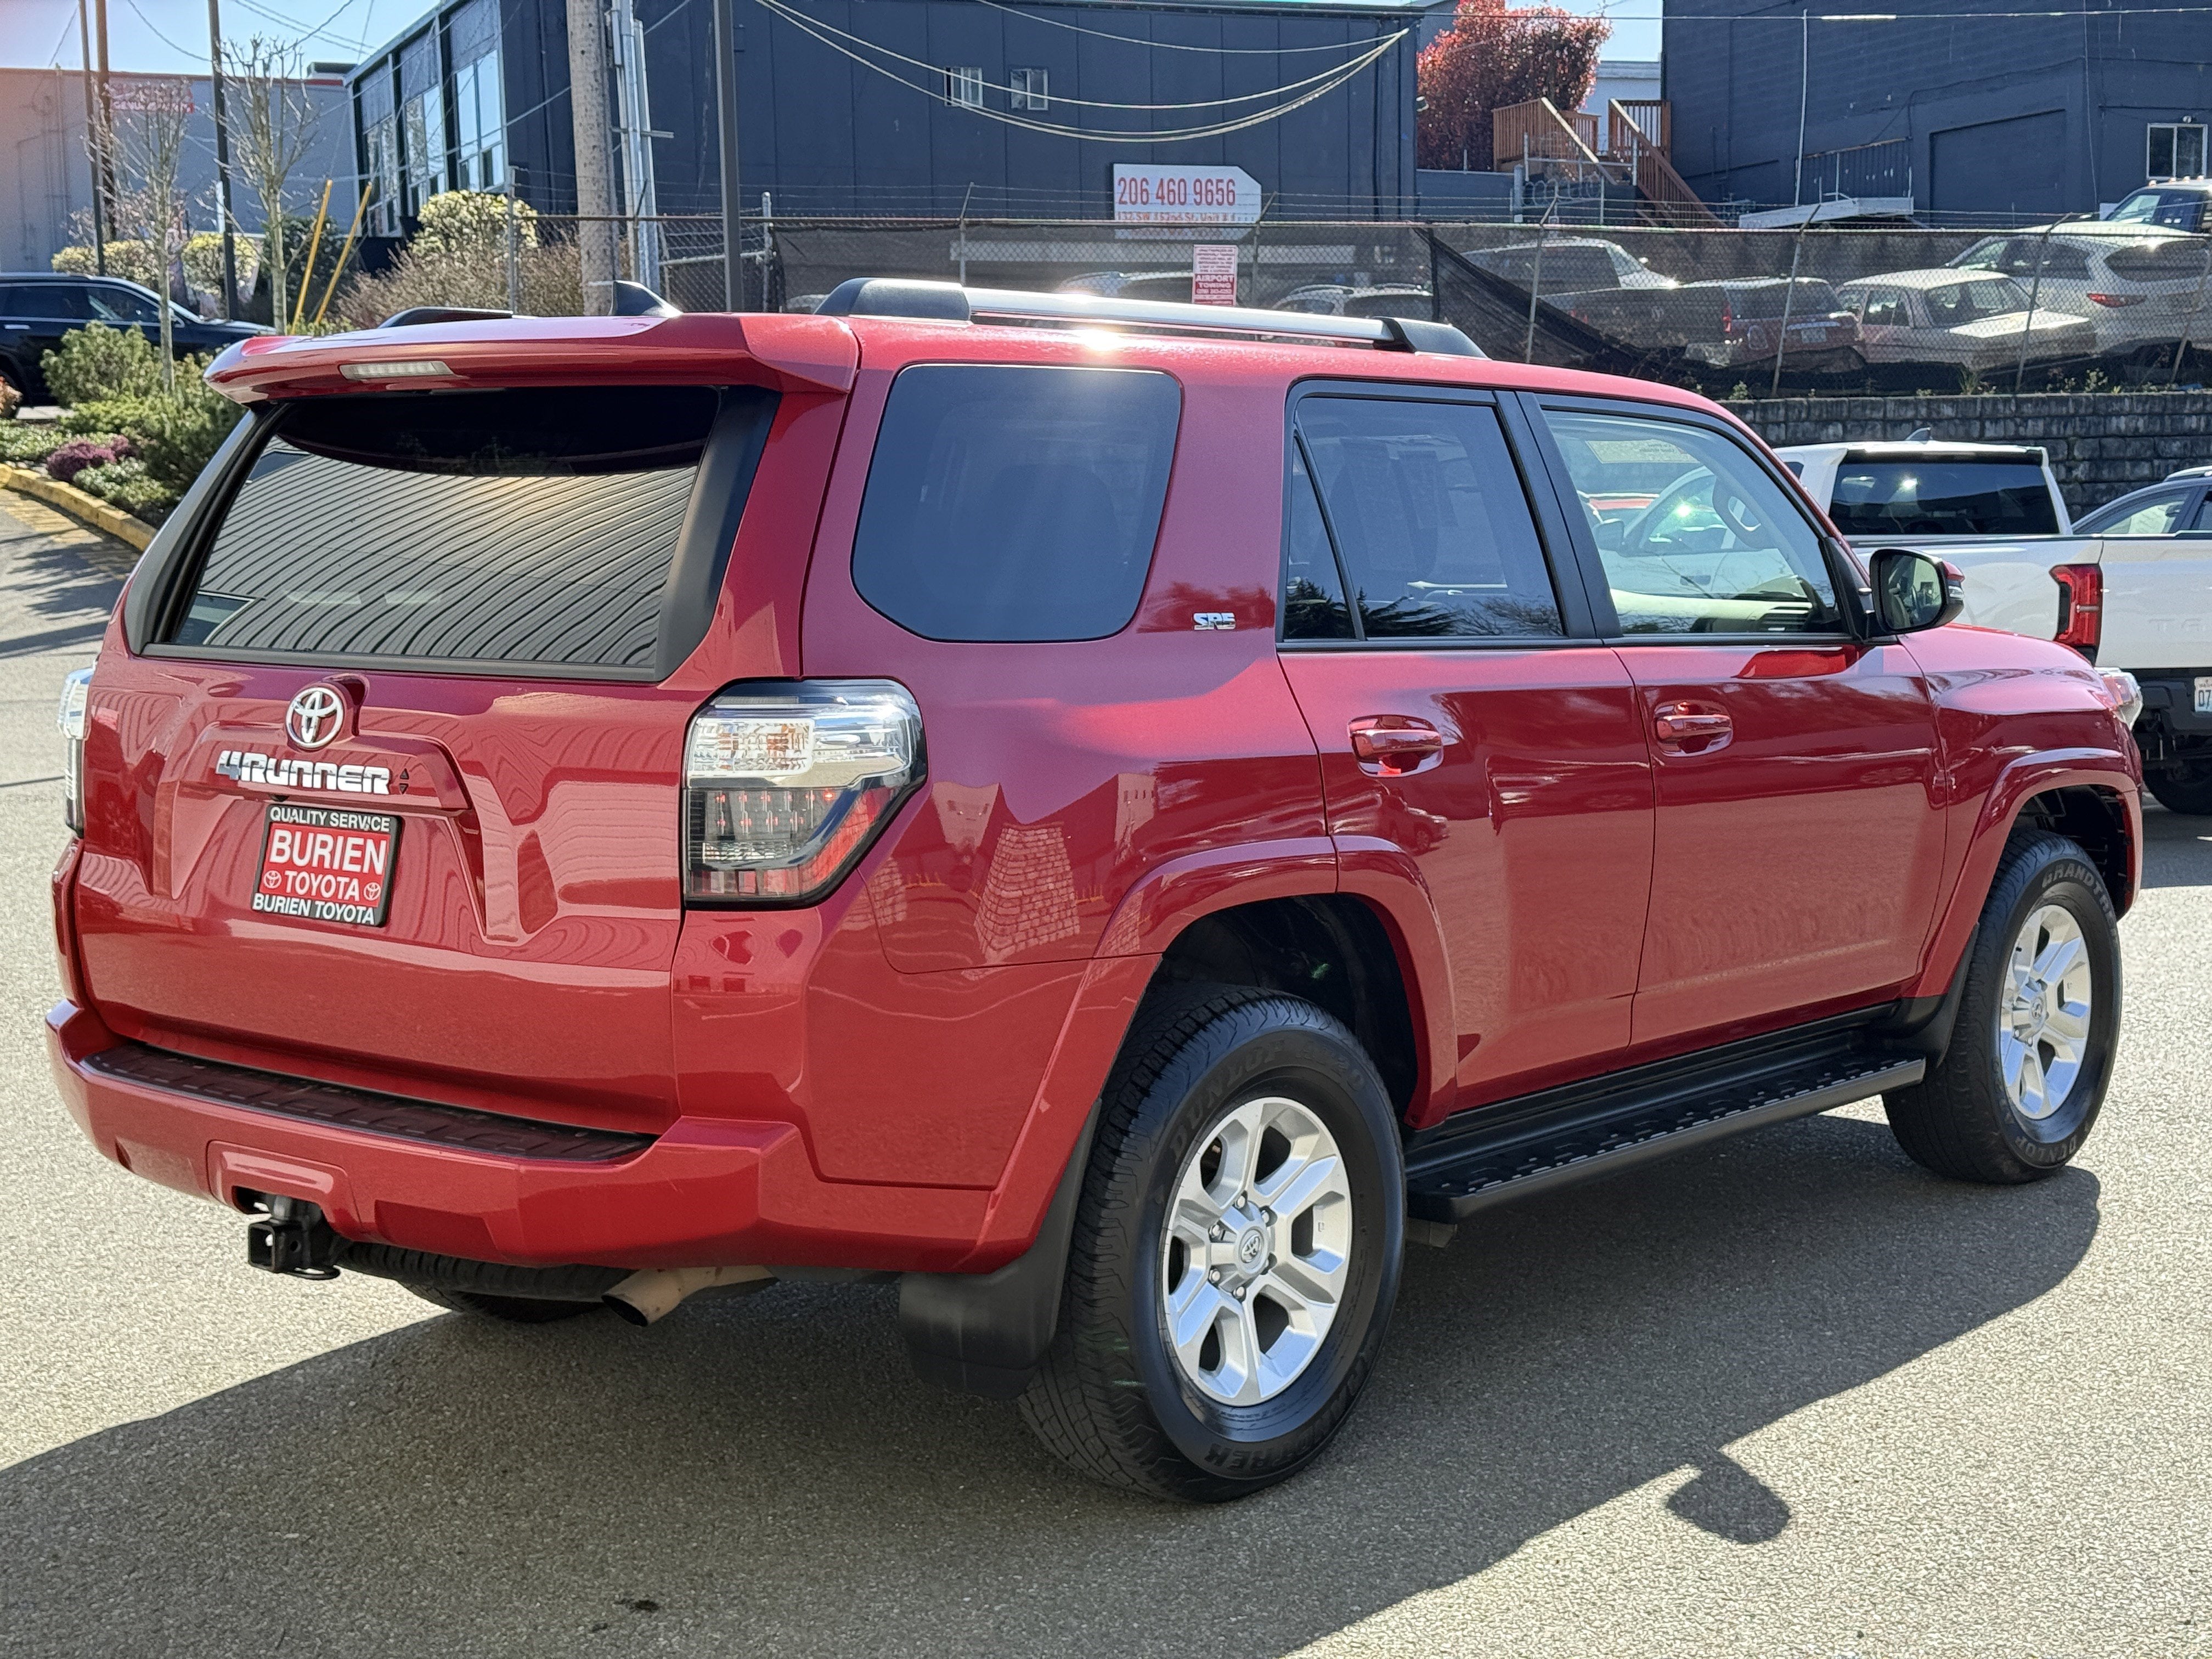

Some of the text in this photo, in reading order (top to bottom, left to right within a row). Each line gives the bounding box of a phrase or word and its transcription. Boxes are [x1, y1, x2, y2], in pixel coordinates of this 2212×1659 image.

[1118, 177, 1235, 206] 206 460 9656
[1193, 612, 1236, 630] SR5
[216, 750, 391, 794] 4RUNNER
[270, 807, 390, 832] QUALITY SERVICE
[269, 829, 387, 875] BURIEN
[284, 871, 360, 902] TOYOTA
[252, 893, 376, 926] BURIEN TOYOTA
[1169, 1039, 1285, 1163] DUNLOP
